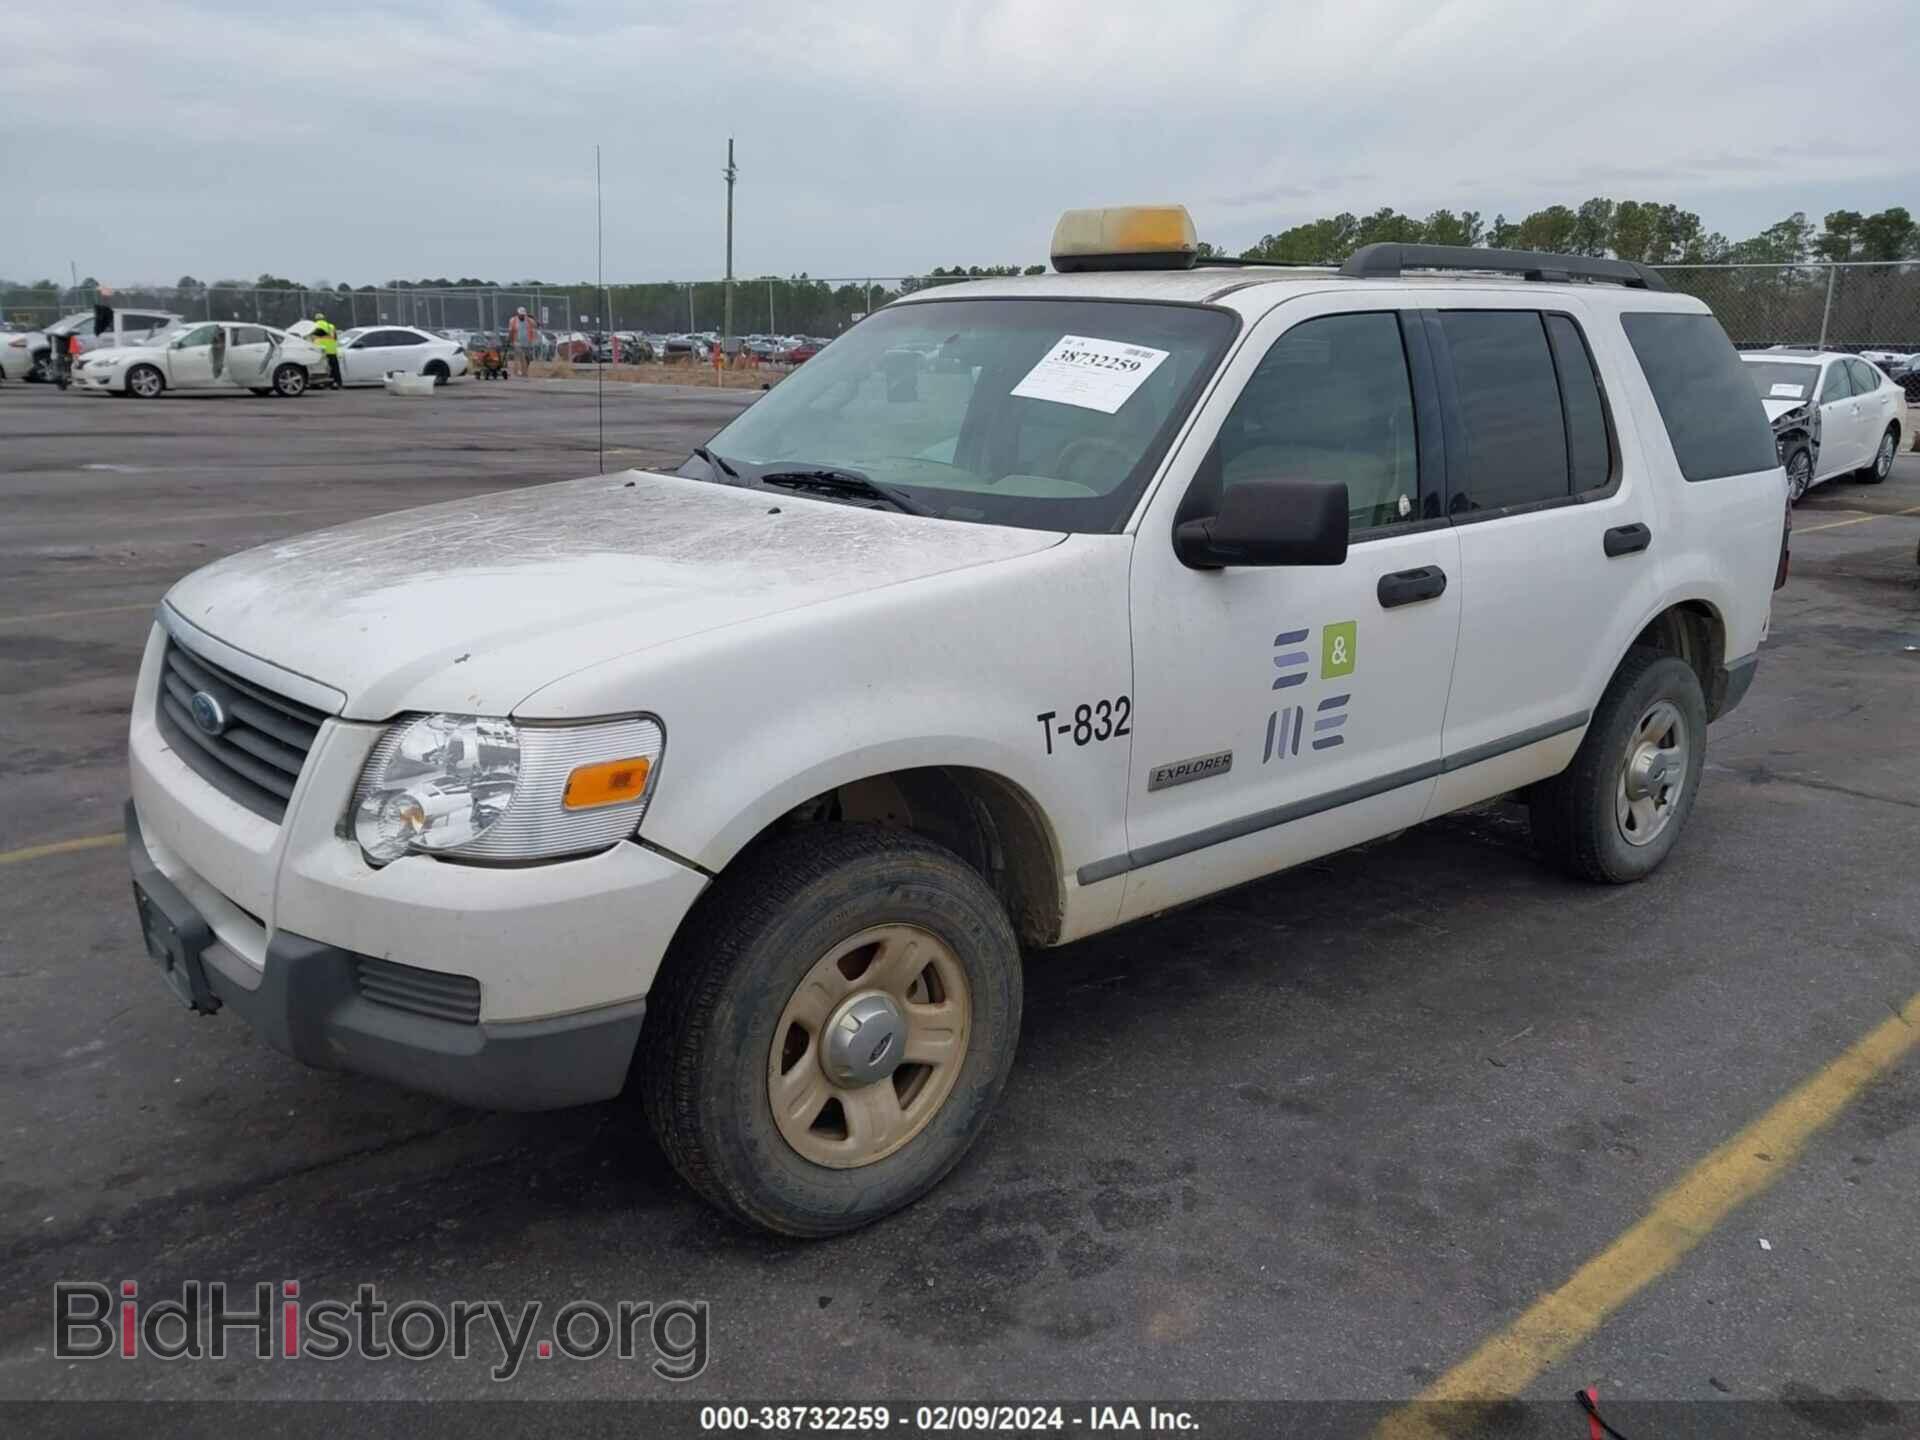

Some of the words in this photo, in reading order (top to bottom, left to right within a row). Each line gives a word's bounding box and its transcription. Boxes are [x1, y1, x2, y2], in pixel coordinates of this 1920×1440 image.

[1053, 350, 1141, 372] 38732259
[1036, 695, 1131, 755] T-832
[1155, 753, 1232, 783] EXPLORER
